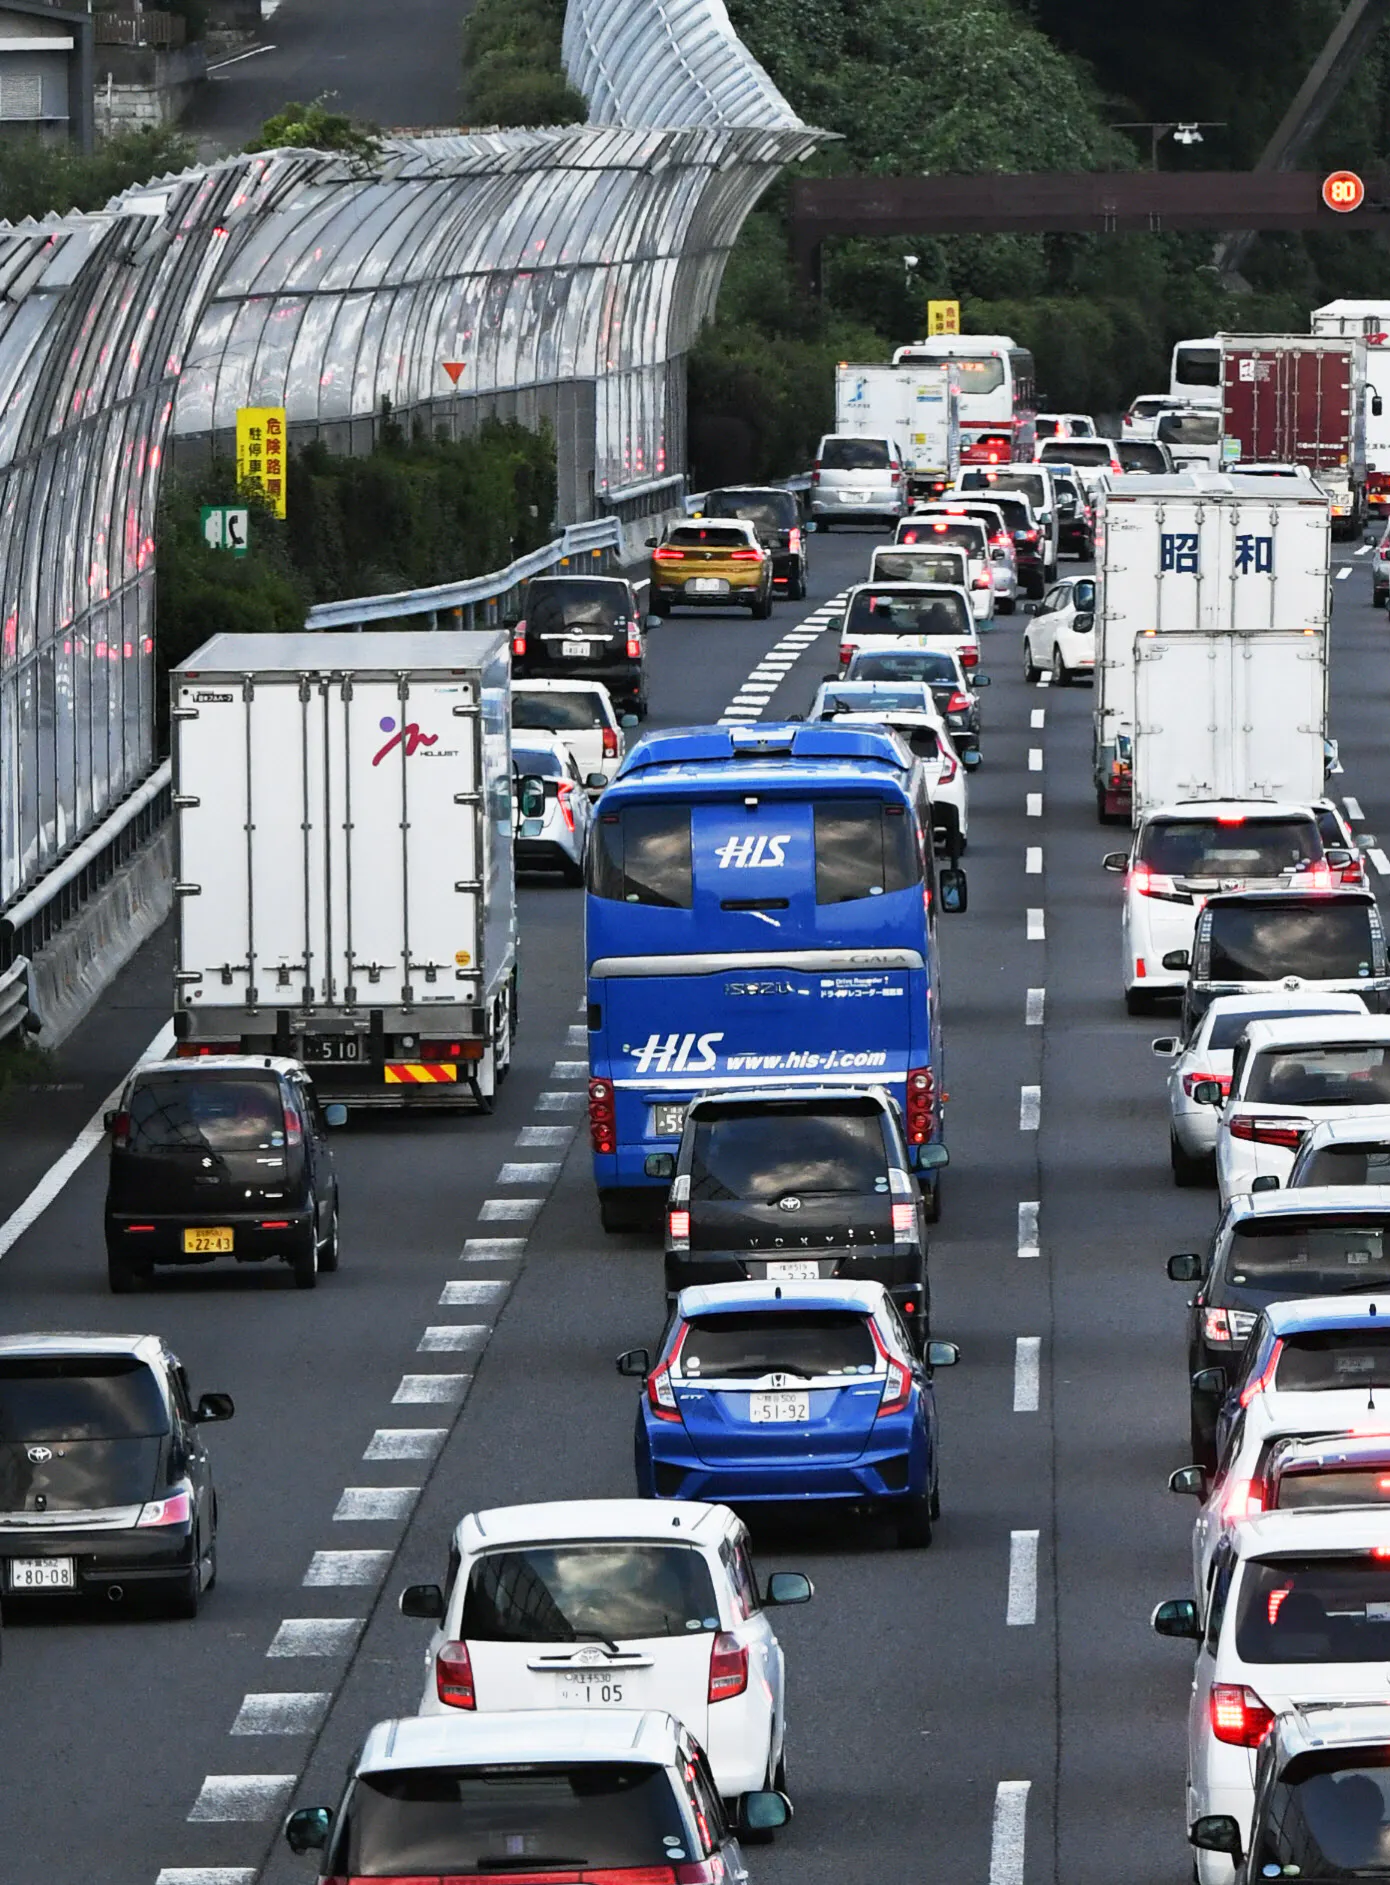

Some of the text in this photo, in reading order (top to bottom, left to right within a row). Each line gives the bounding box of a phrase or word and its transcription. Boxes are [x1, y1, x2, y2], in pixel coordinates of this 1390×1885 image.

[1332, 181, 1356, 202] 80
[850, 954, 906, 964] GALA
[725, 980, 796, 996] ISUZU
[727, 1051, 887, 1070] www.his-j.com
[750, 1236, 834, 1247] VOXY
[763, 1404, 806, 1419] 51-92
[25, 1569, 69, 1585] 80-08
